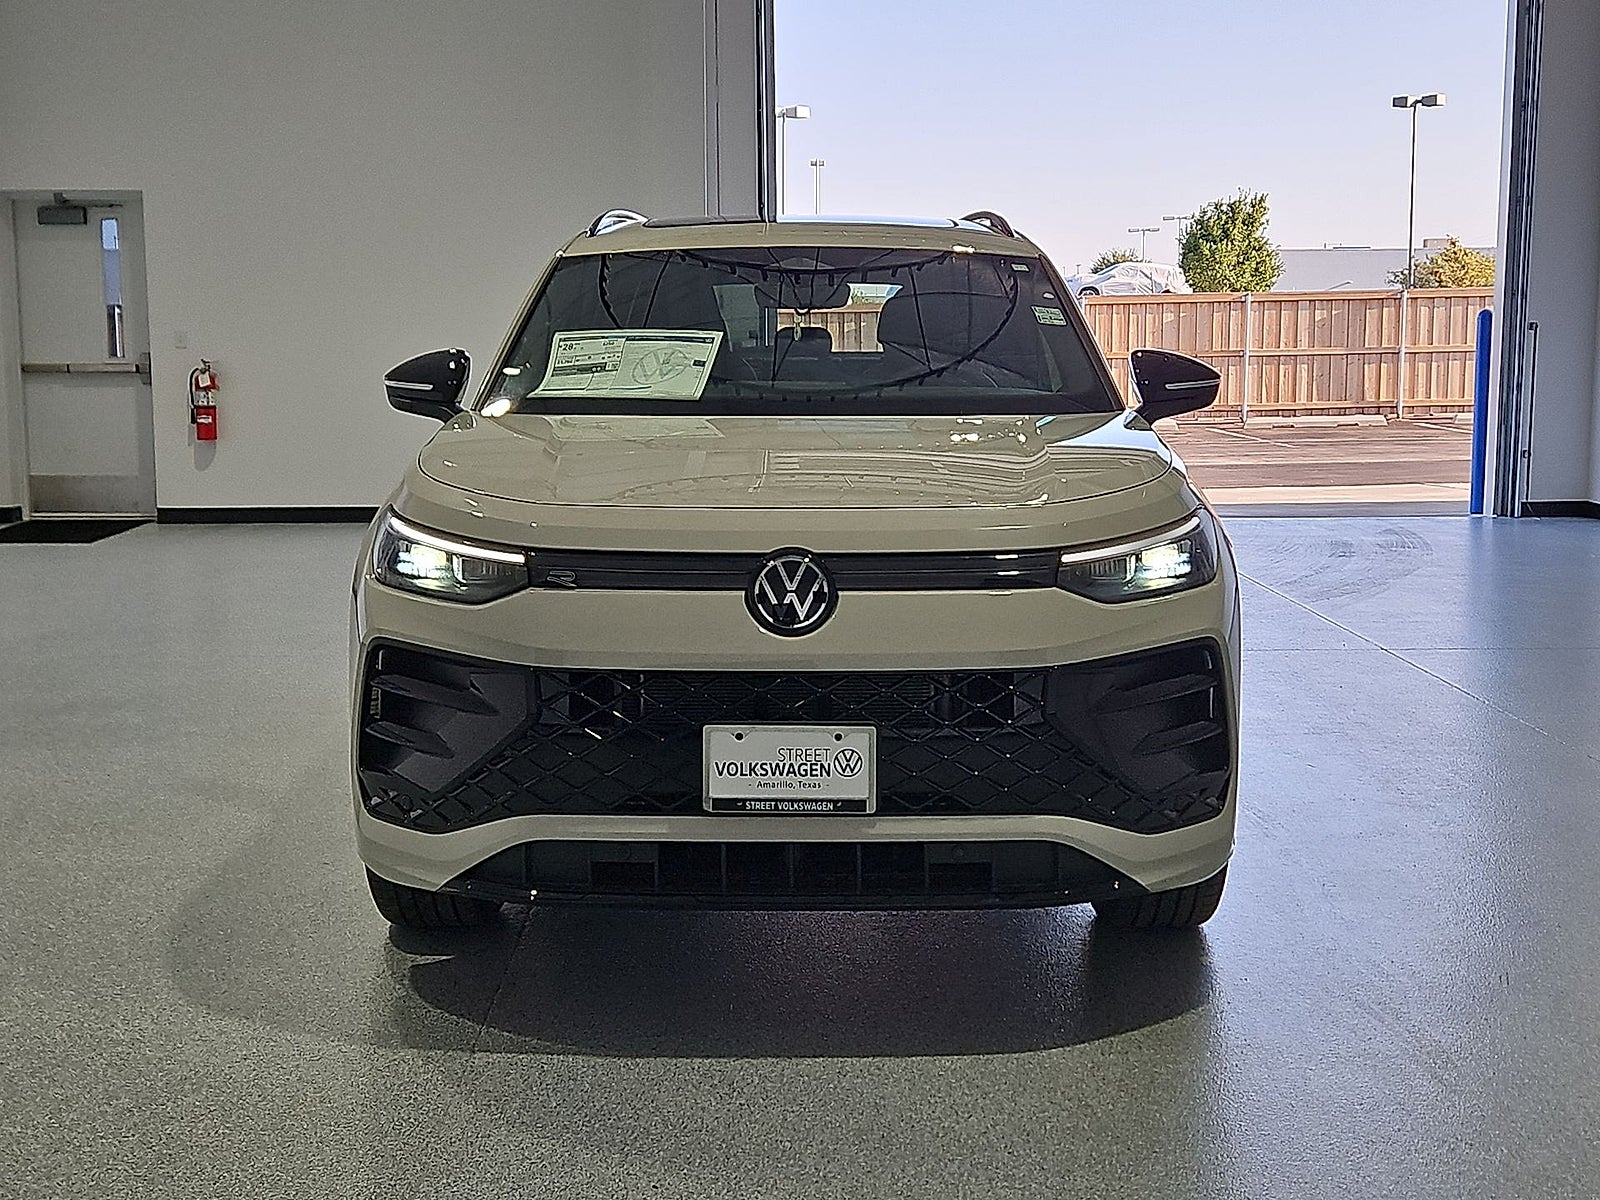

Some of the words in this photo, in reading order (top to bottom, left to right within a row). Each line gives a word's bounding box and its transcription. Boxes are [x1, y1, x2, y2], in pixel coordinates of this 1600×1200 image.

[777, 748, 832, 763] STREET
[715, 761, 832, 778] VOLKSWAGEN
[756, 780, 796, 790] Amarillo,
[797, 780, 822, 789] Texas
[745, 801, 776, 811] STREET
[777, 801, 834, 811] VOLKSWAGEN
